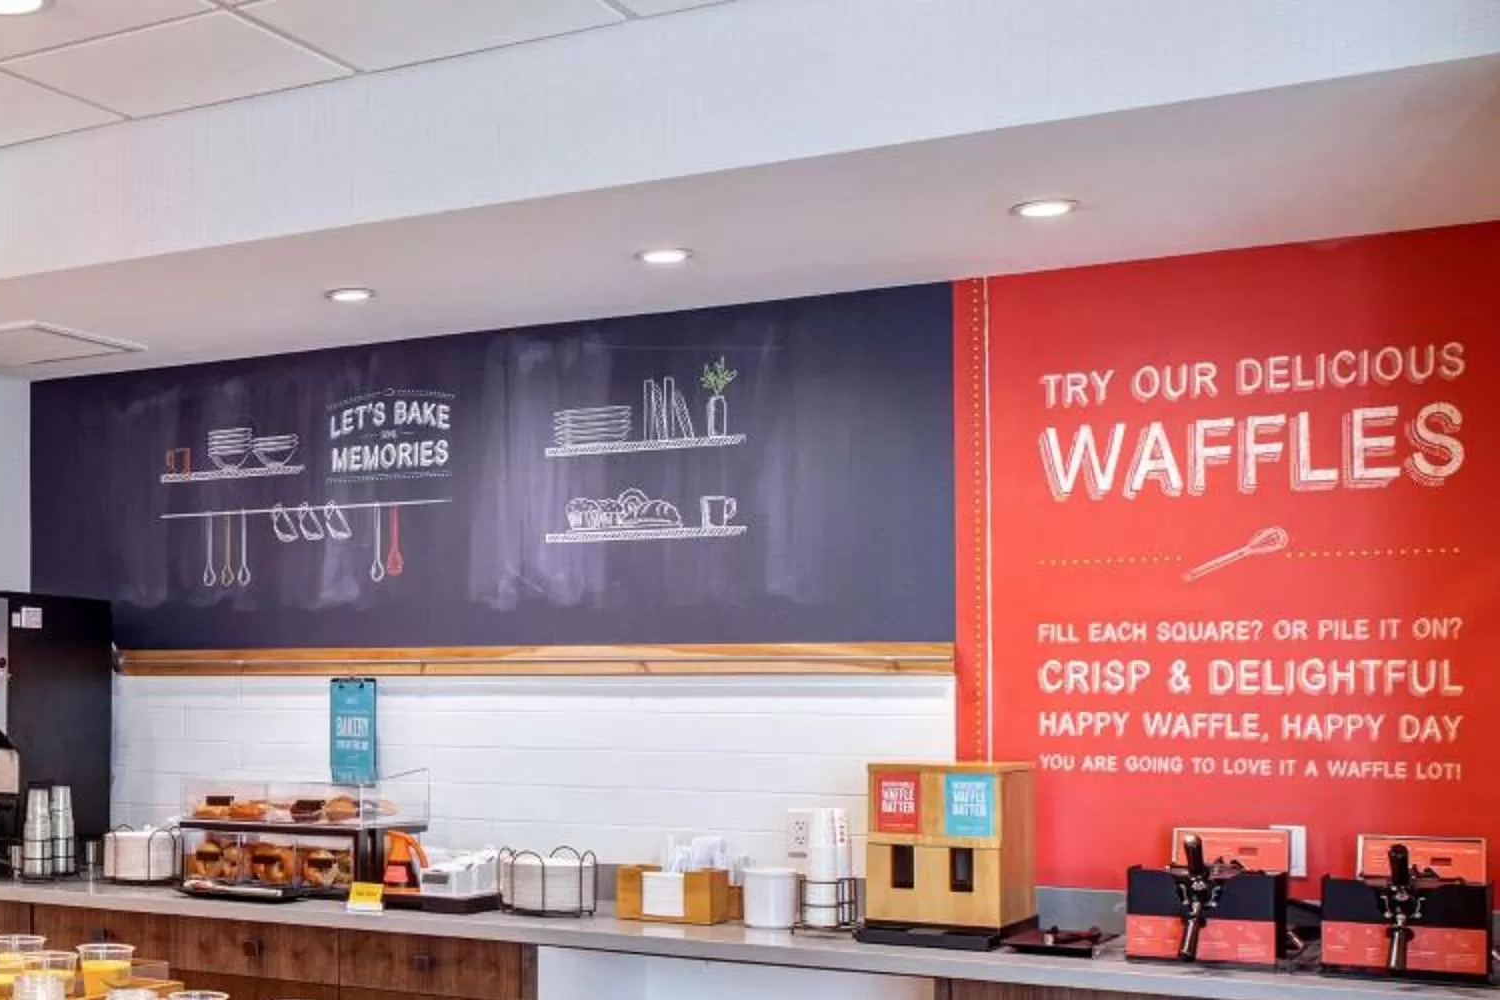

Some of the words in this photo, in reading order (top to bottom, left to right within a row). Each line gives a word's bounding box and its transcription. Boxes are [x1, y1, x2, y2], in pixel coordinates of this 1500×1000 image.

[1039, 369, 1114, 409] TRY
[1131, 362, 1219, 402] OUR
[1236, 341, 1466, 396] DELICIOUS
[330, 401, 386, 439] LET'S
[393, 400, 451, 430] BAKE
[330, 439, 450, 473] MEMORIES
[1038, 400, 1466, 503] WAFFLES
[1038, 622, 1080, 643] FILL
[1088, 621, 1147, 643] EACH
[1156, 619, 1263, 643] SQUARE?
[1272, 619, 1309, 641] OR
[1317, 618, 1370, 641] PILE
[1379, 618, 1402, 641] IT
[1412, 617, 1464, 641] ON?
[1038, 659, 1152, 695] CRISP
[1166, 659, 1192, 695] &
[1207, 657, 1465, 696] DELIGHTFUL
[1038, 711, 1130, 738] HAPPY
[1143, 713, 1270, 743] WAFFLE,
[1281, 713, 1386, 742] HAPPY
[1399, 713, 1465, 744] DAY
[1039, 754, 1076, 772] YOU
[1081, 755, 1119, 773] ARE
[1124, 755, 1183, 774] GOING
[1191, 757, 1215, 775] TO
[1222, 758, 1272, 777] LOVE
[1279, 758, 1297, 777] IT
[1304, 759, 1319, 778] A
[1325, 759, 1408, 779] WAFFLE
[1415, 761, 1462, 781] LOT!
